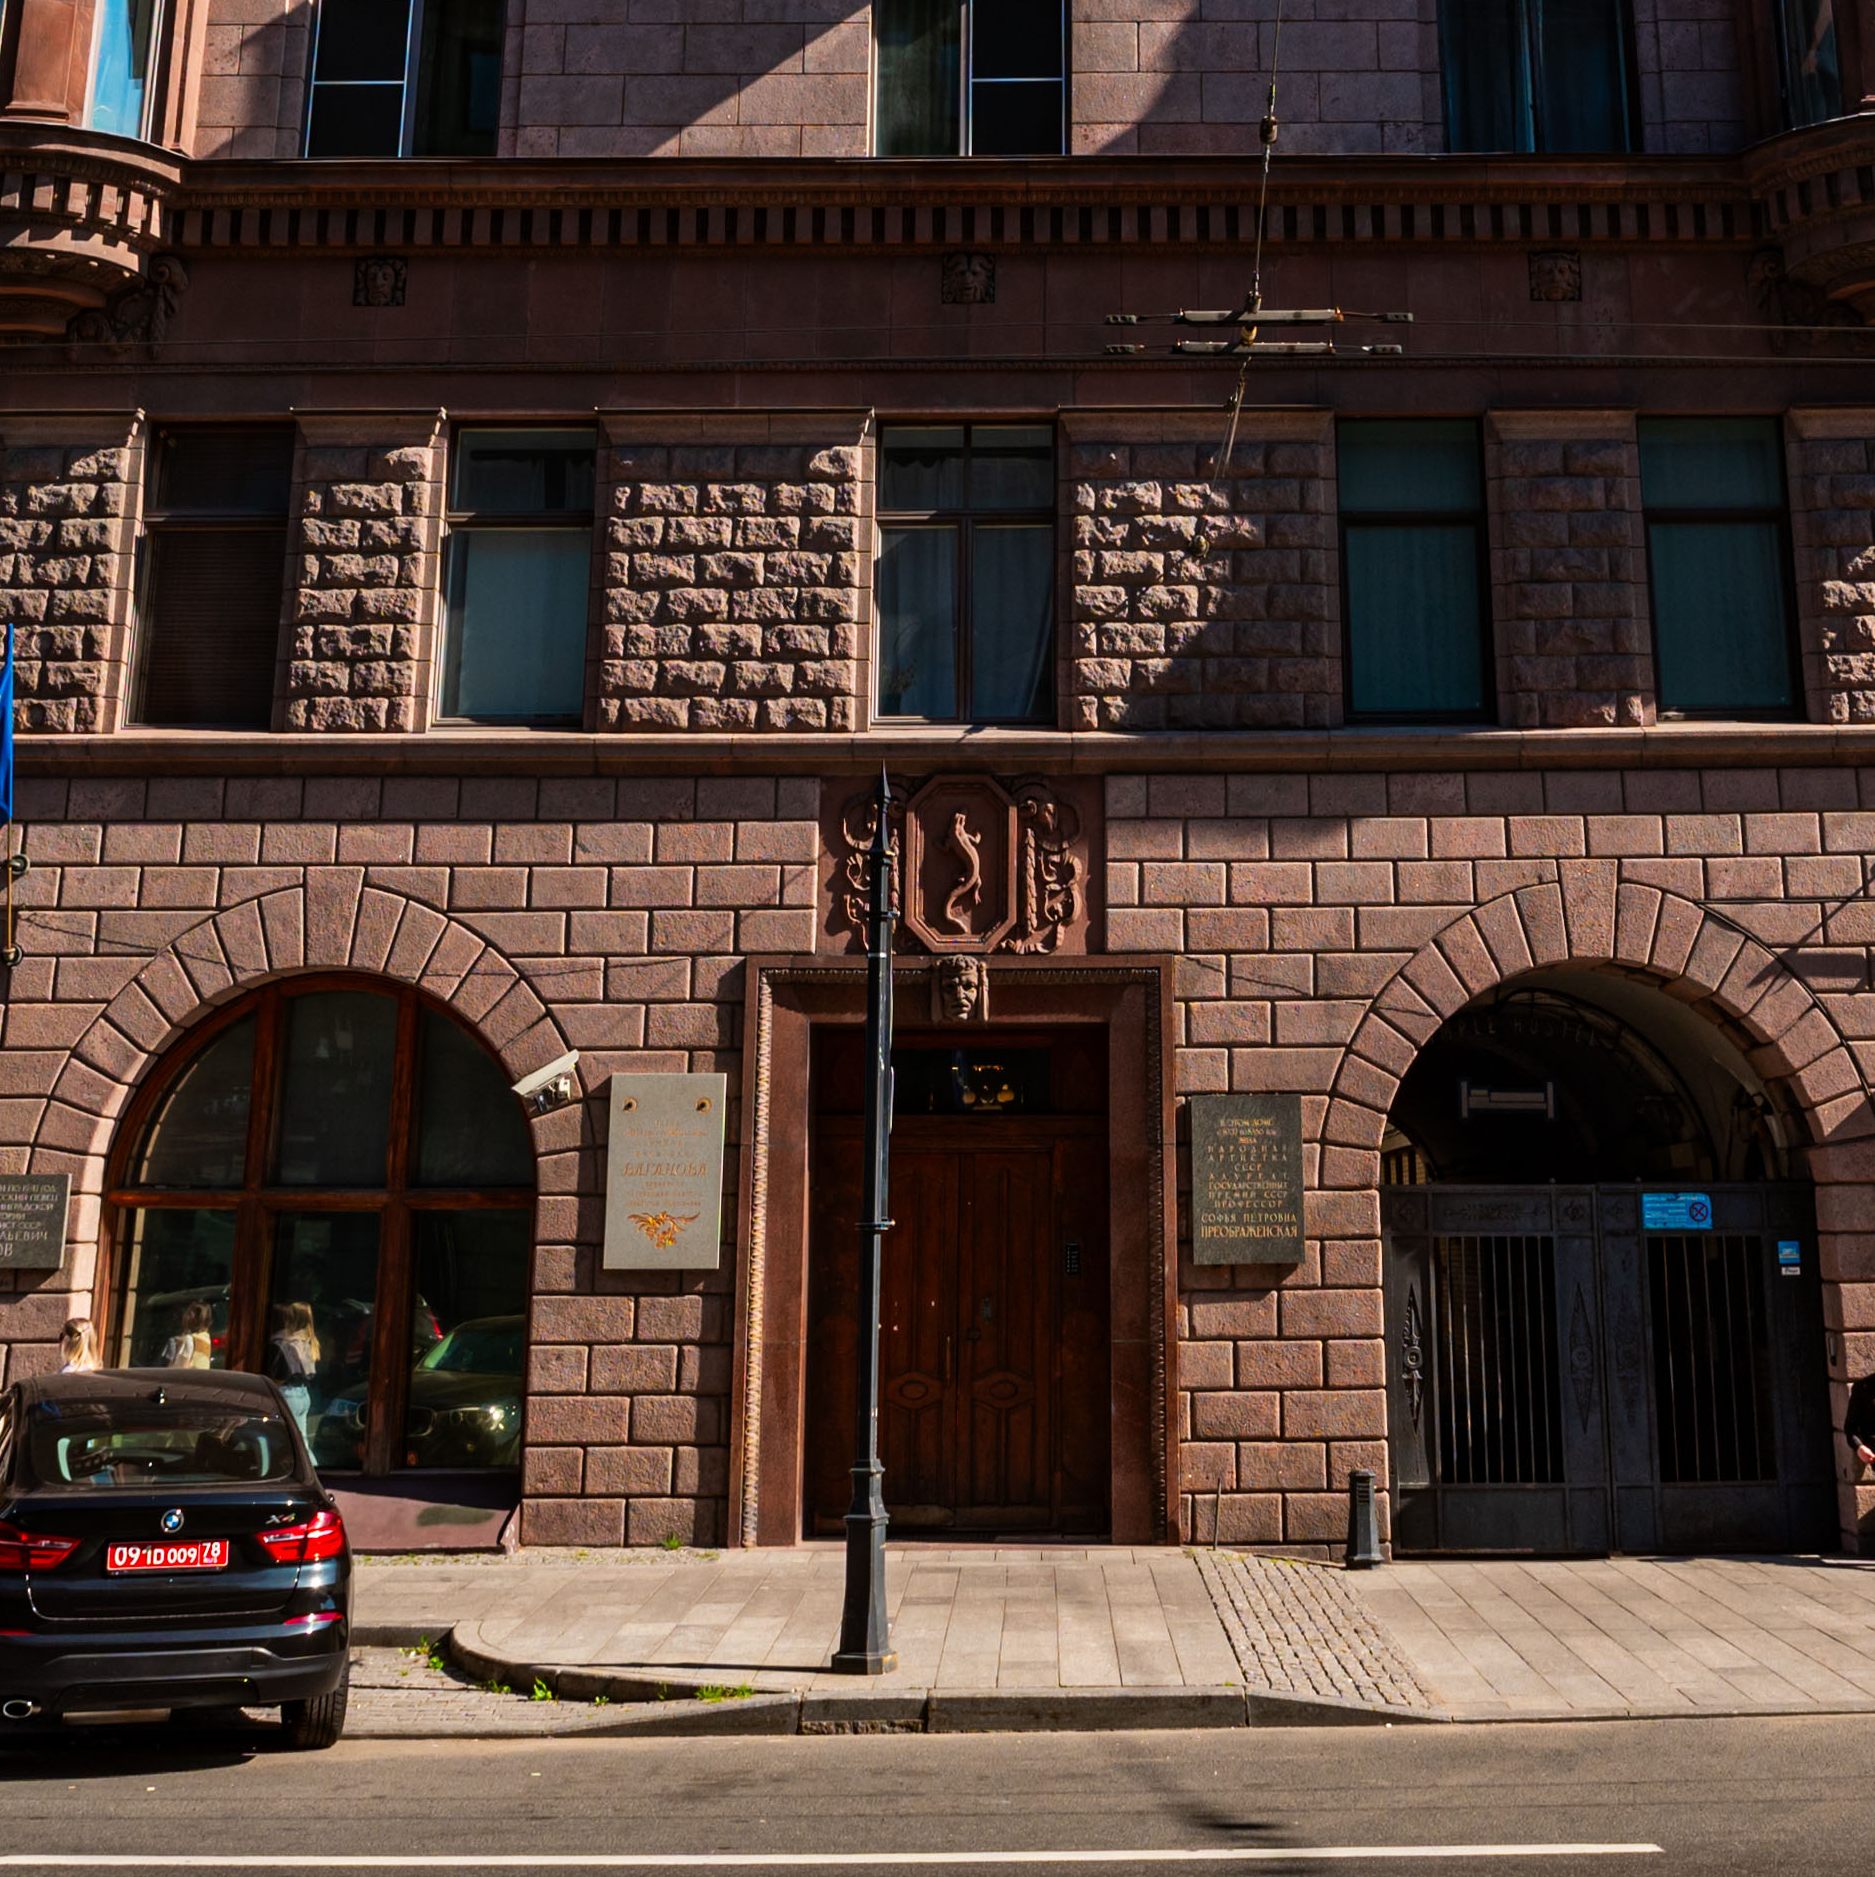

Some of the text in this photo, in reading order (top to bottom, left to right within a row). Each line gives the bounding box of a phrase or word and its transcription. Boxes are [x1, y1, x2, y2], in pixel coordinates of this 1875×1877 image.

[1201, 1213, 1297, 1223] СОФЬЯ ПЕТРОВНА
[1201, 1225, 1298, 1239] ПРЕОБРАЖЕНСКАЯ
[202, 1541, 221, 1557] 78
